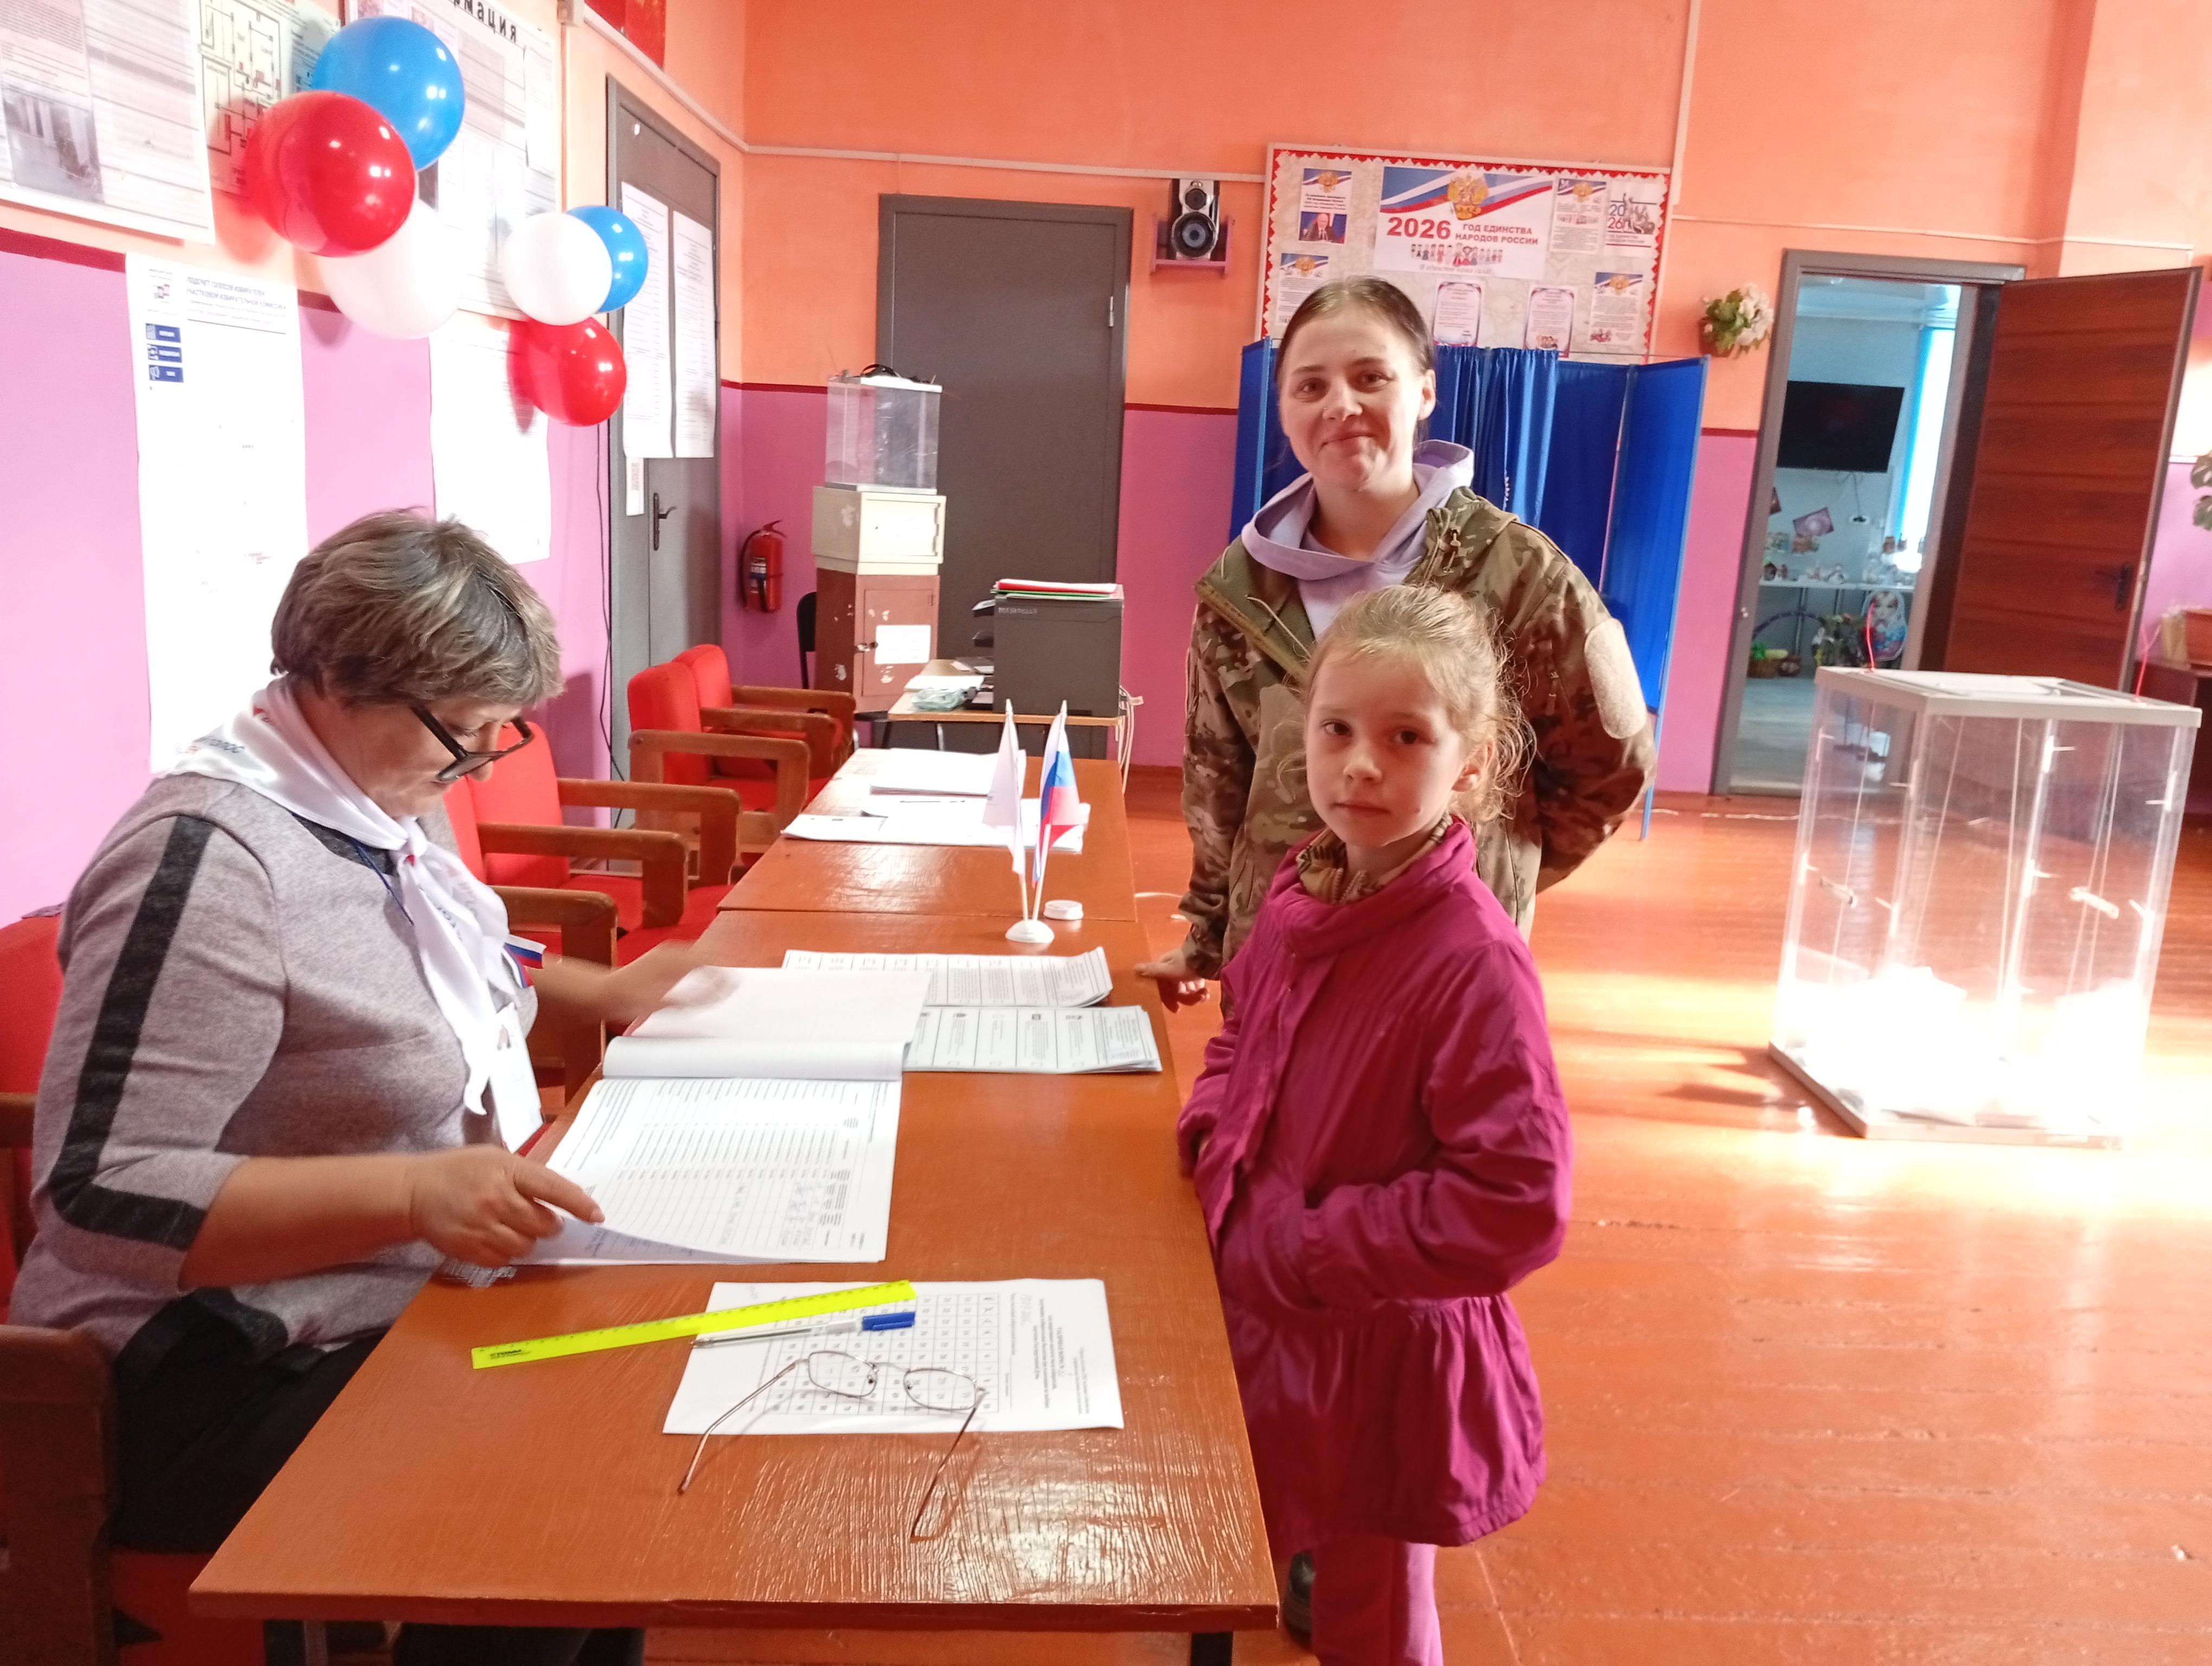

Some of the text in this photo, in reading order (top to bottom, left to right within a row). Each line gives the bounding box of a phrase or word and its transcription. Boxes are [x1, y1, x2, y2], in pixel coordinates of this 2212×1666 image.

[1610, 204, 1625, 216] 20
[1387, 216, 1451, 240] 2026
[1463, 223, 1532, 235] ГОД ЕДИНСТВА
[1607, 217, 1623, 229] 26
[1455, 233, 1539, 245] НАРОДОВ РОССИИ
